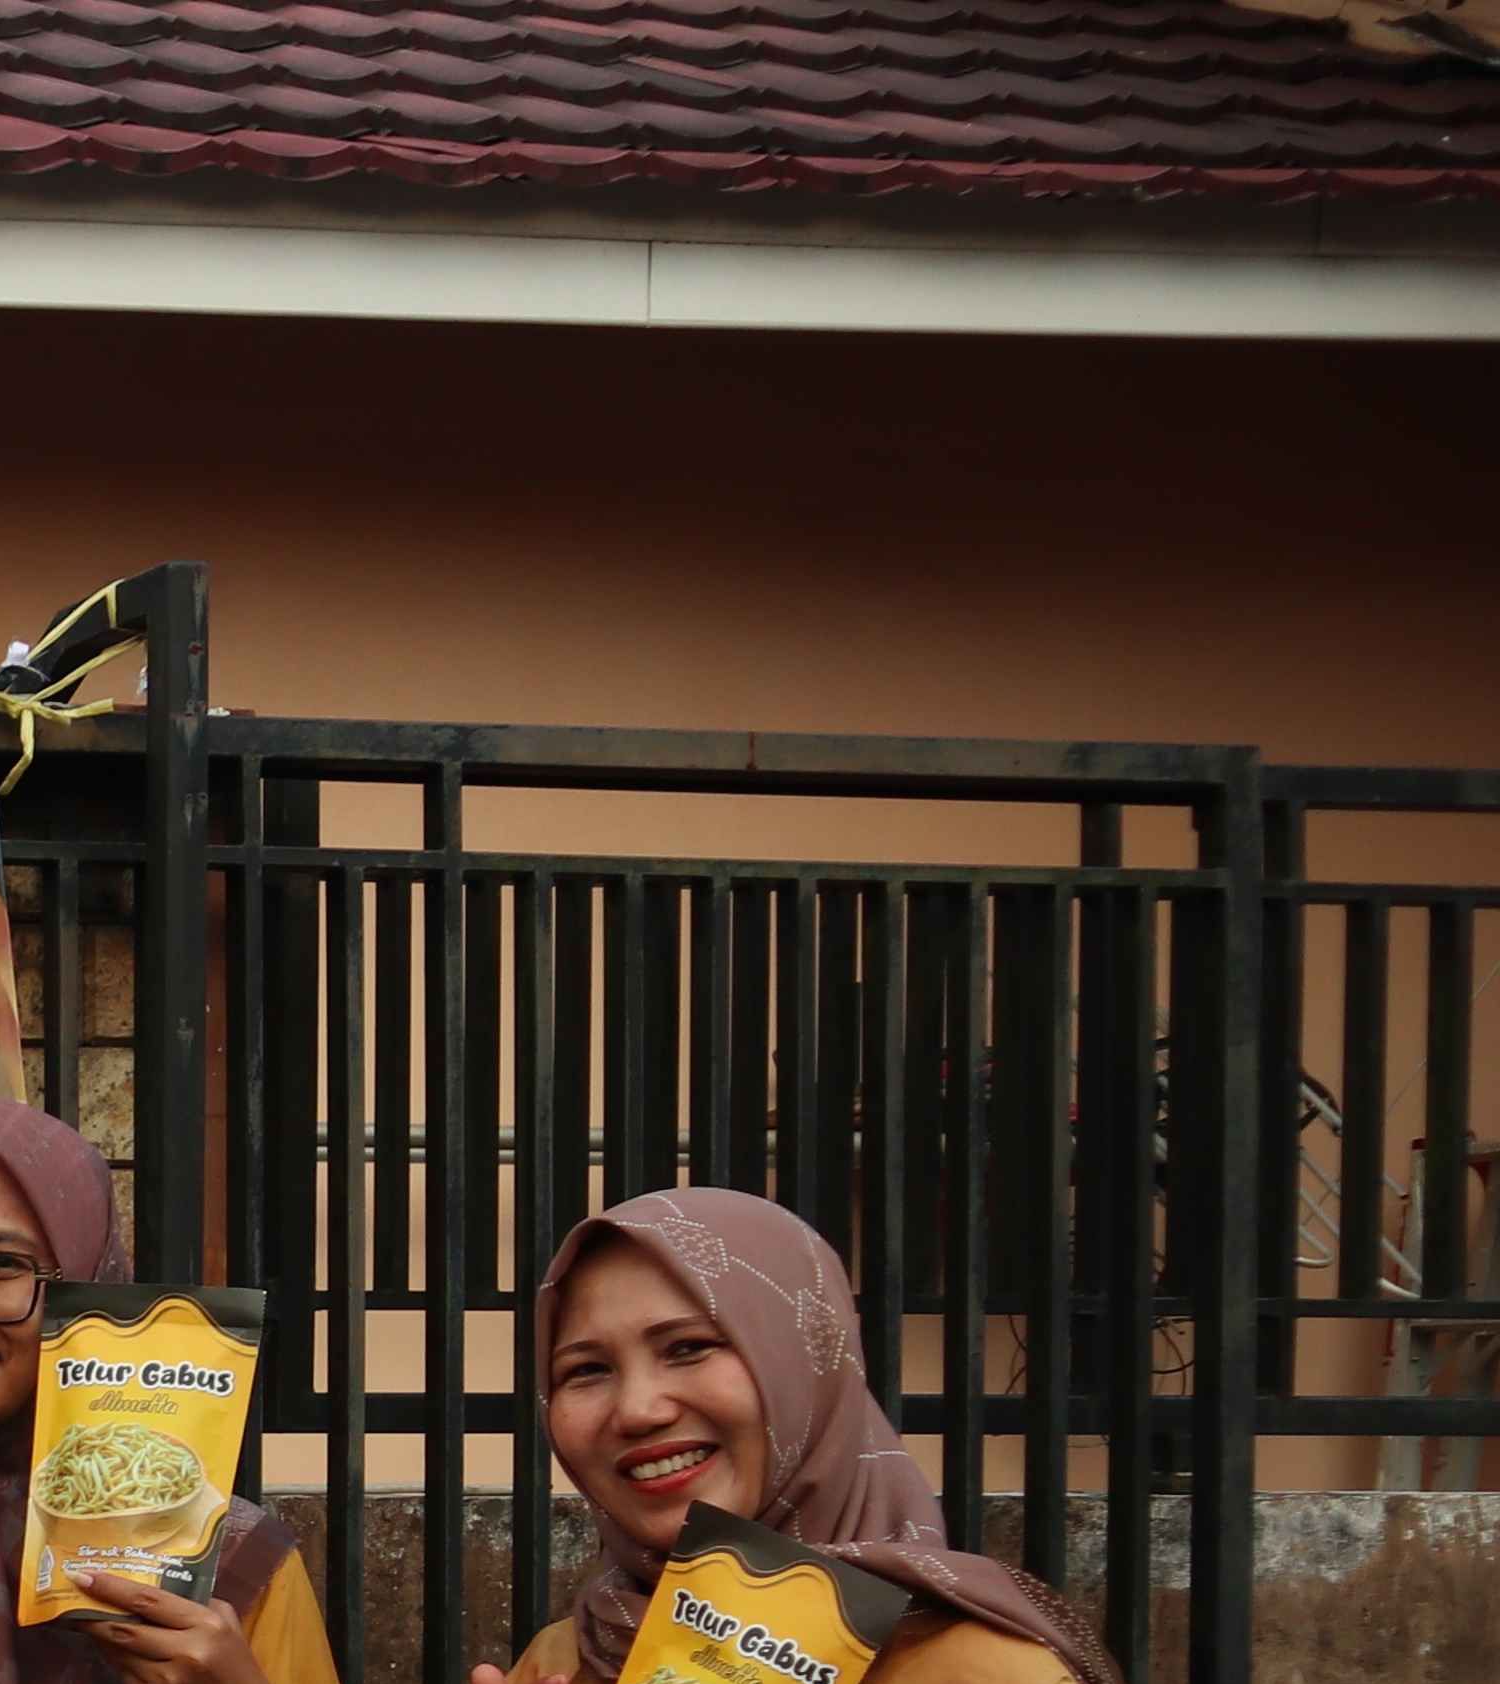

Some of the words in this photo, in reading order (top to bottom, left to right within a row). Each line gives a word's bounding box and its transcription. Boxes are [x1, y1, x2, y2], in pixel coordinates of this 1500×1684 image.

[57, 1359, 135, 1388] Telur
[139, 1361, 235, 1396] Gabus
[671, 1589, 740, 1641] Telur
